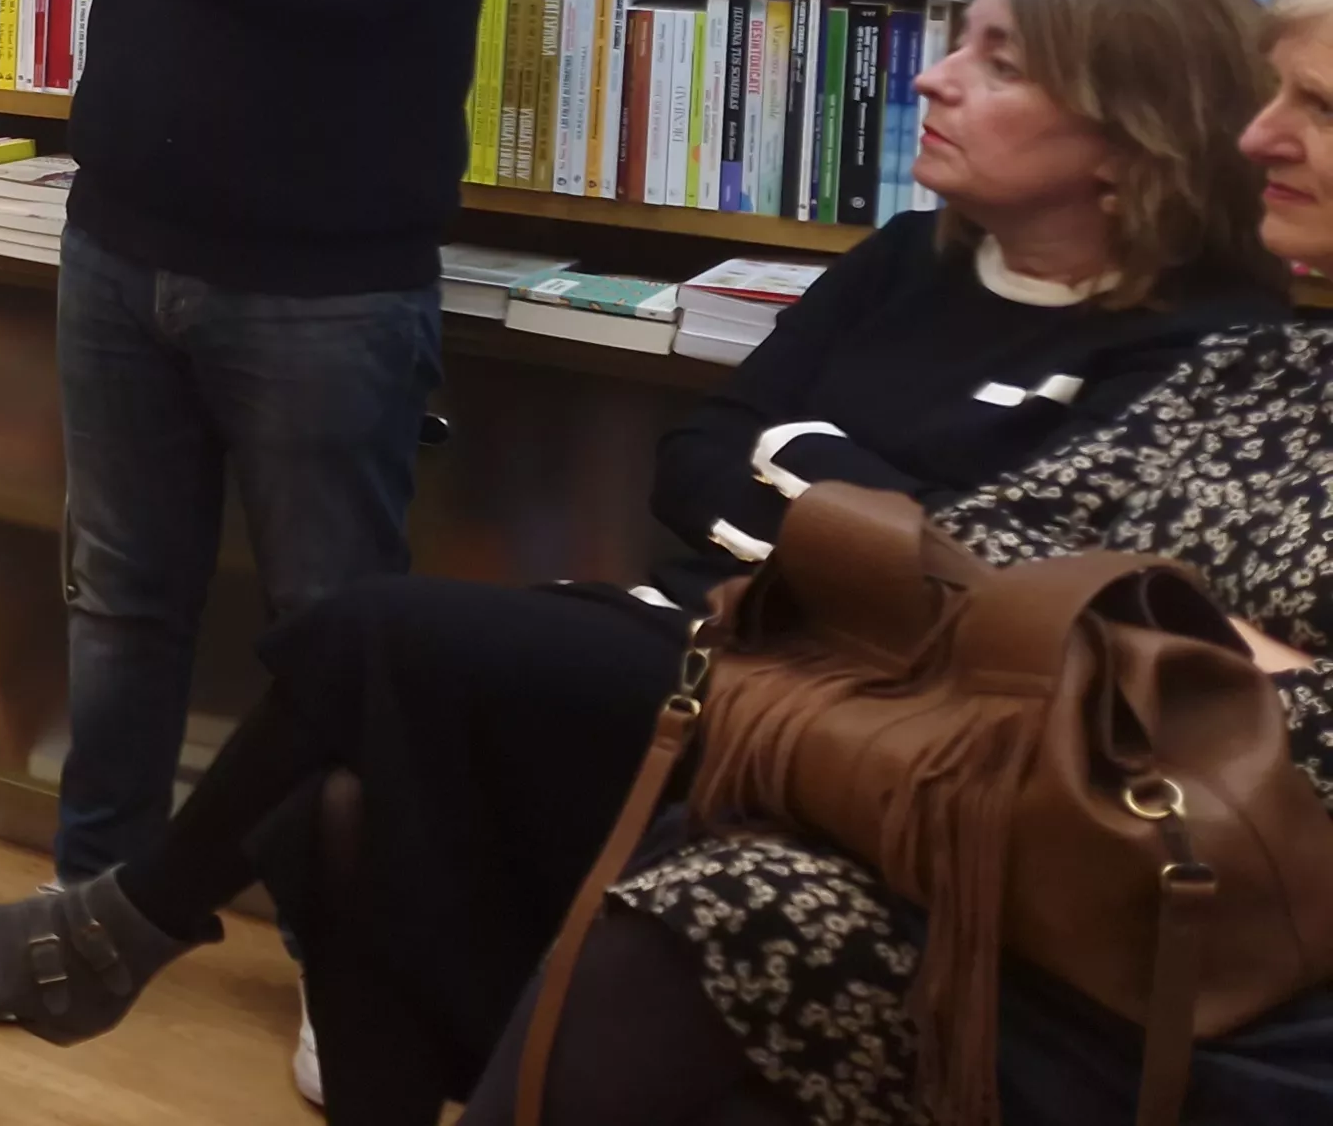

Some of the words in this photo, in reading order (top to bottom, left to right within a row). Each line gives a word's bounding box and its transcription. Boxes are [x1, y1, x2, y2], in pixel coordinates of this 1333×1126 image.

[732, 6, 744, 46] ILUMINA
[730, 47, 742, 65] TUS
[728, 65, 741, 110] SOMBRAS
[671, 85, 686, 143] DIGNIDAD
